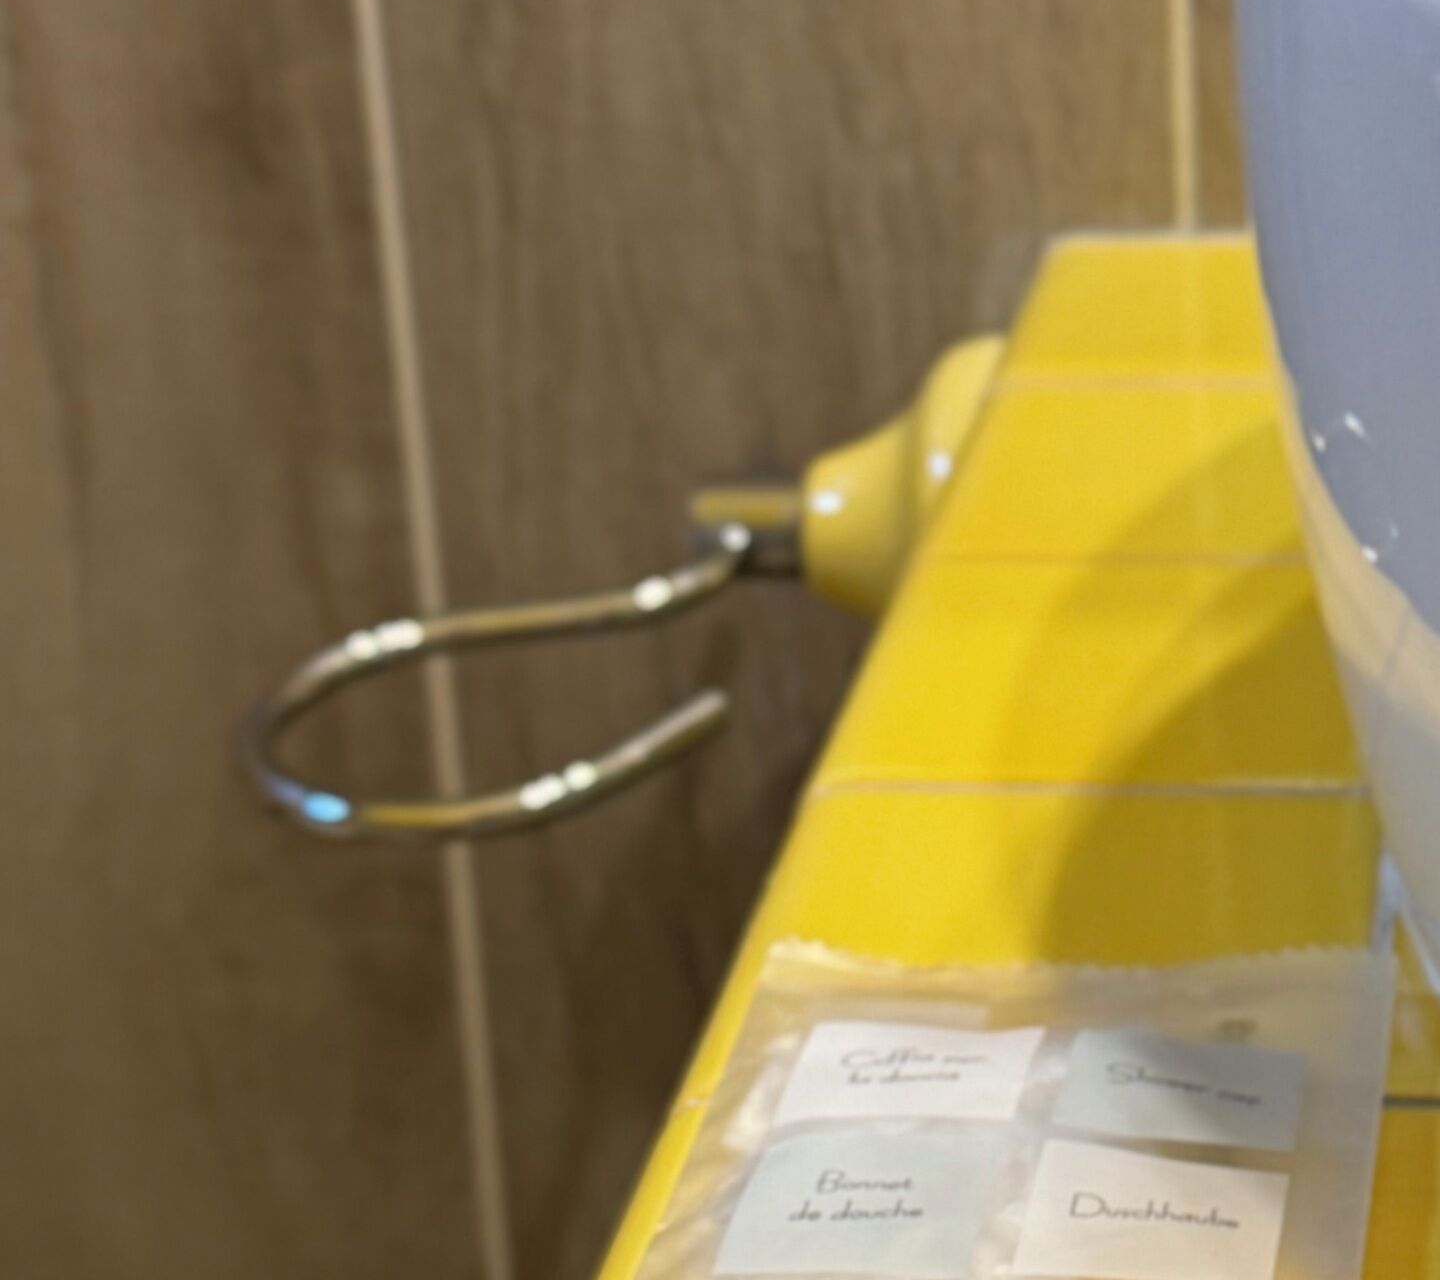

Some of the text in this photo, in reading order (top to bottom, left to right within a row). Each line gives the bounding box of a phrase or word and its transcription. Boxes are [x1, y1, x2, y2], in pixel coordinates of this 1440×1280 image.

[815, 1169, 912, 1195] Bonnet
[788, 1198, 923, 1221] de douche
